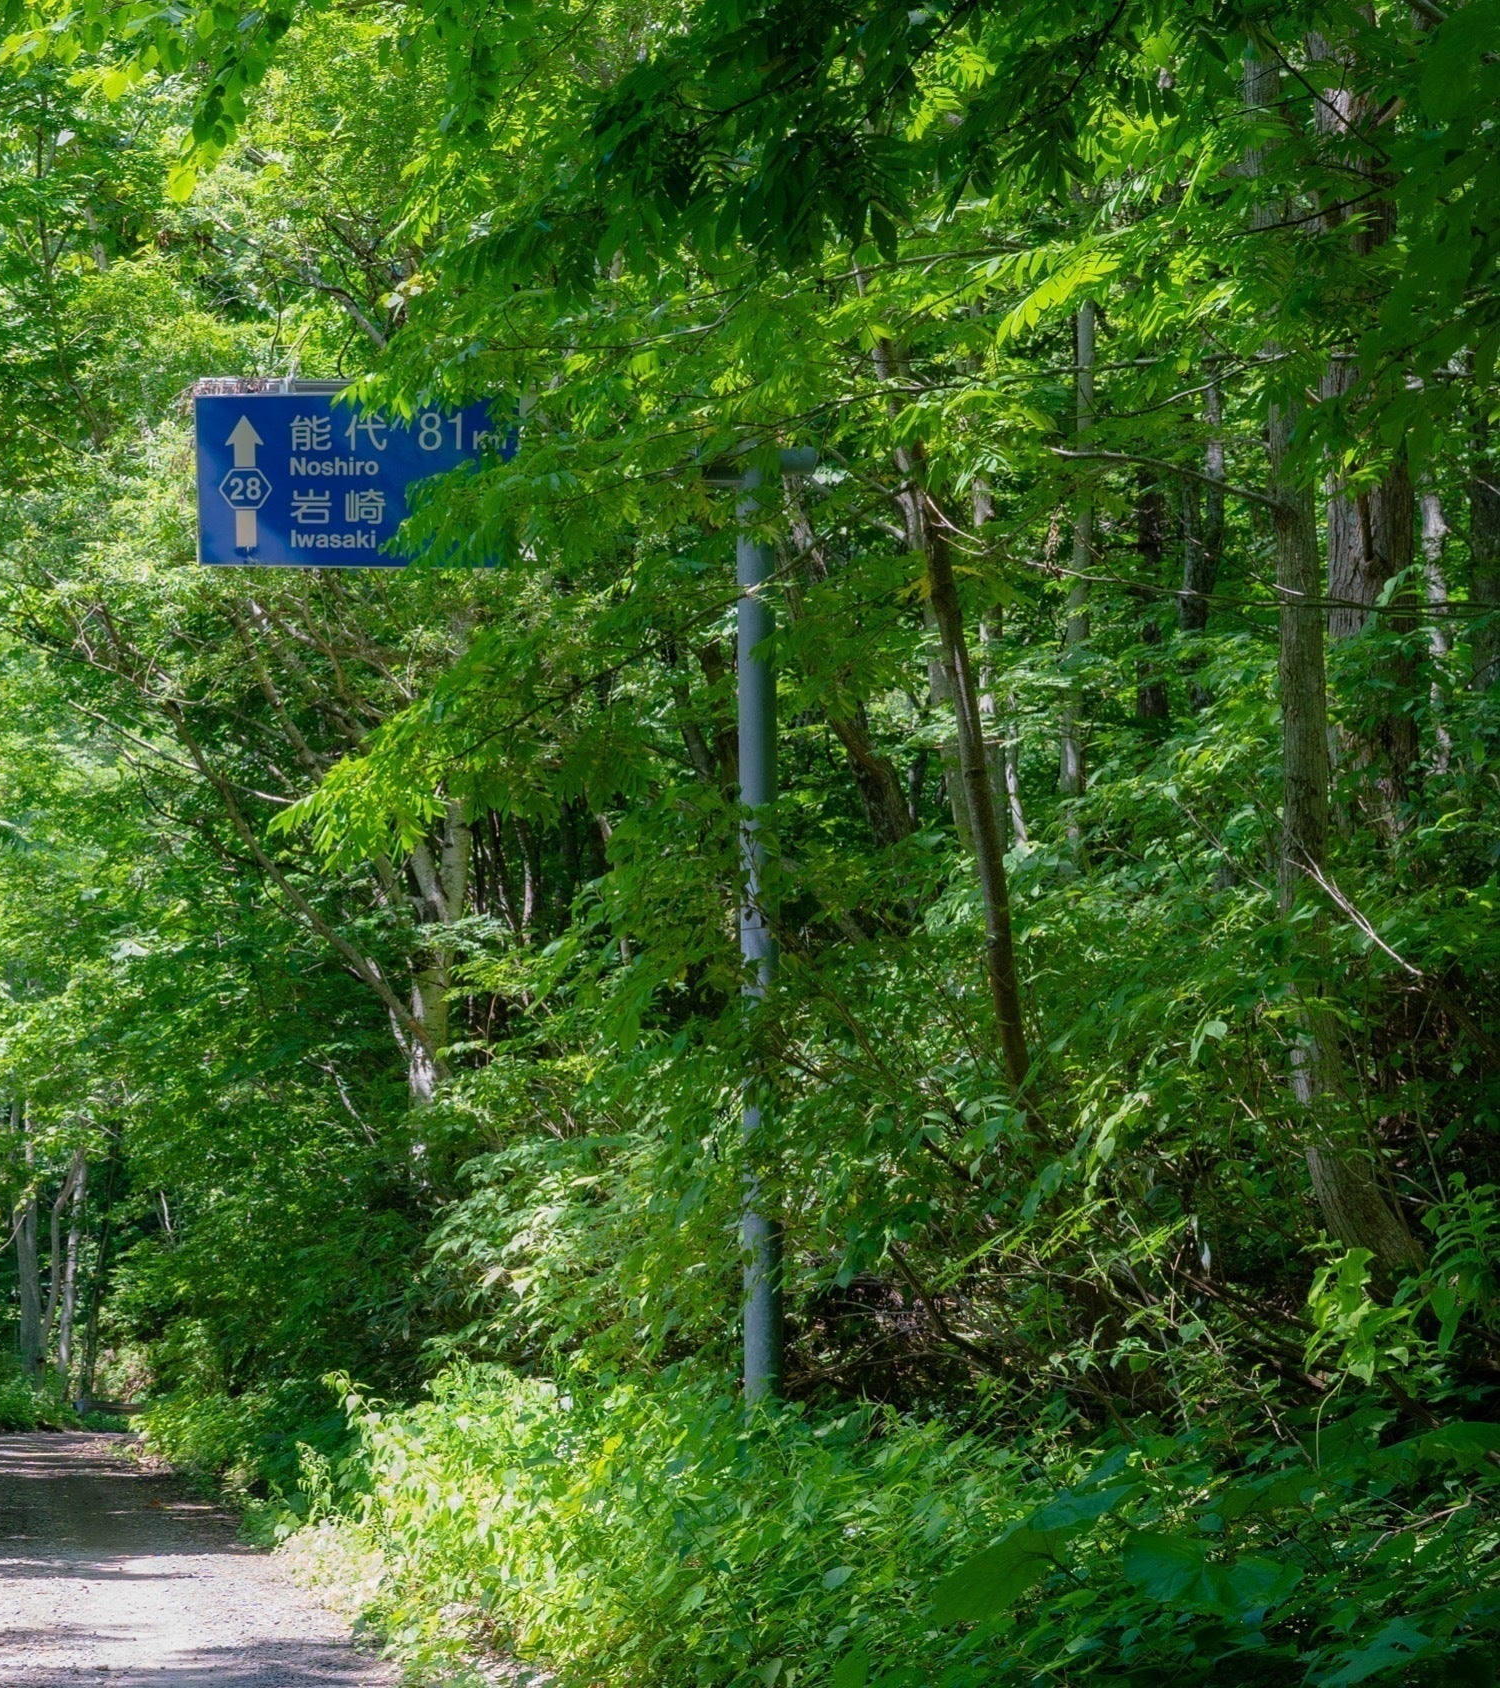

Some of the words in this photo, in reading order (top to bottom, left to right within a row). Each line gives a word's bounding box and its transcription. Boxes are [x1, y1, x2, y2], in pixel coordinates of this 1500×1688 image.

[290, 414, 387, 451] 能代
[290, 456, 379, 476] Noshiro
[229, 478, 262, 501] 28
[290, 488, 386, 525] 岩崎
[290, 529, 377, 549] Iwasaki
